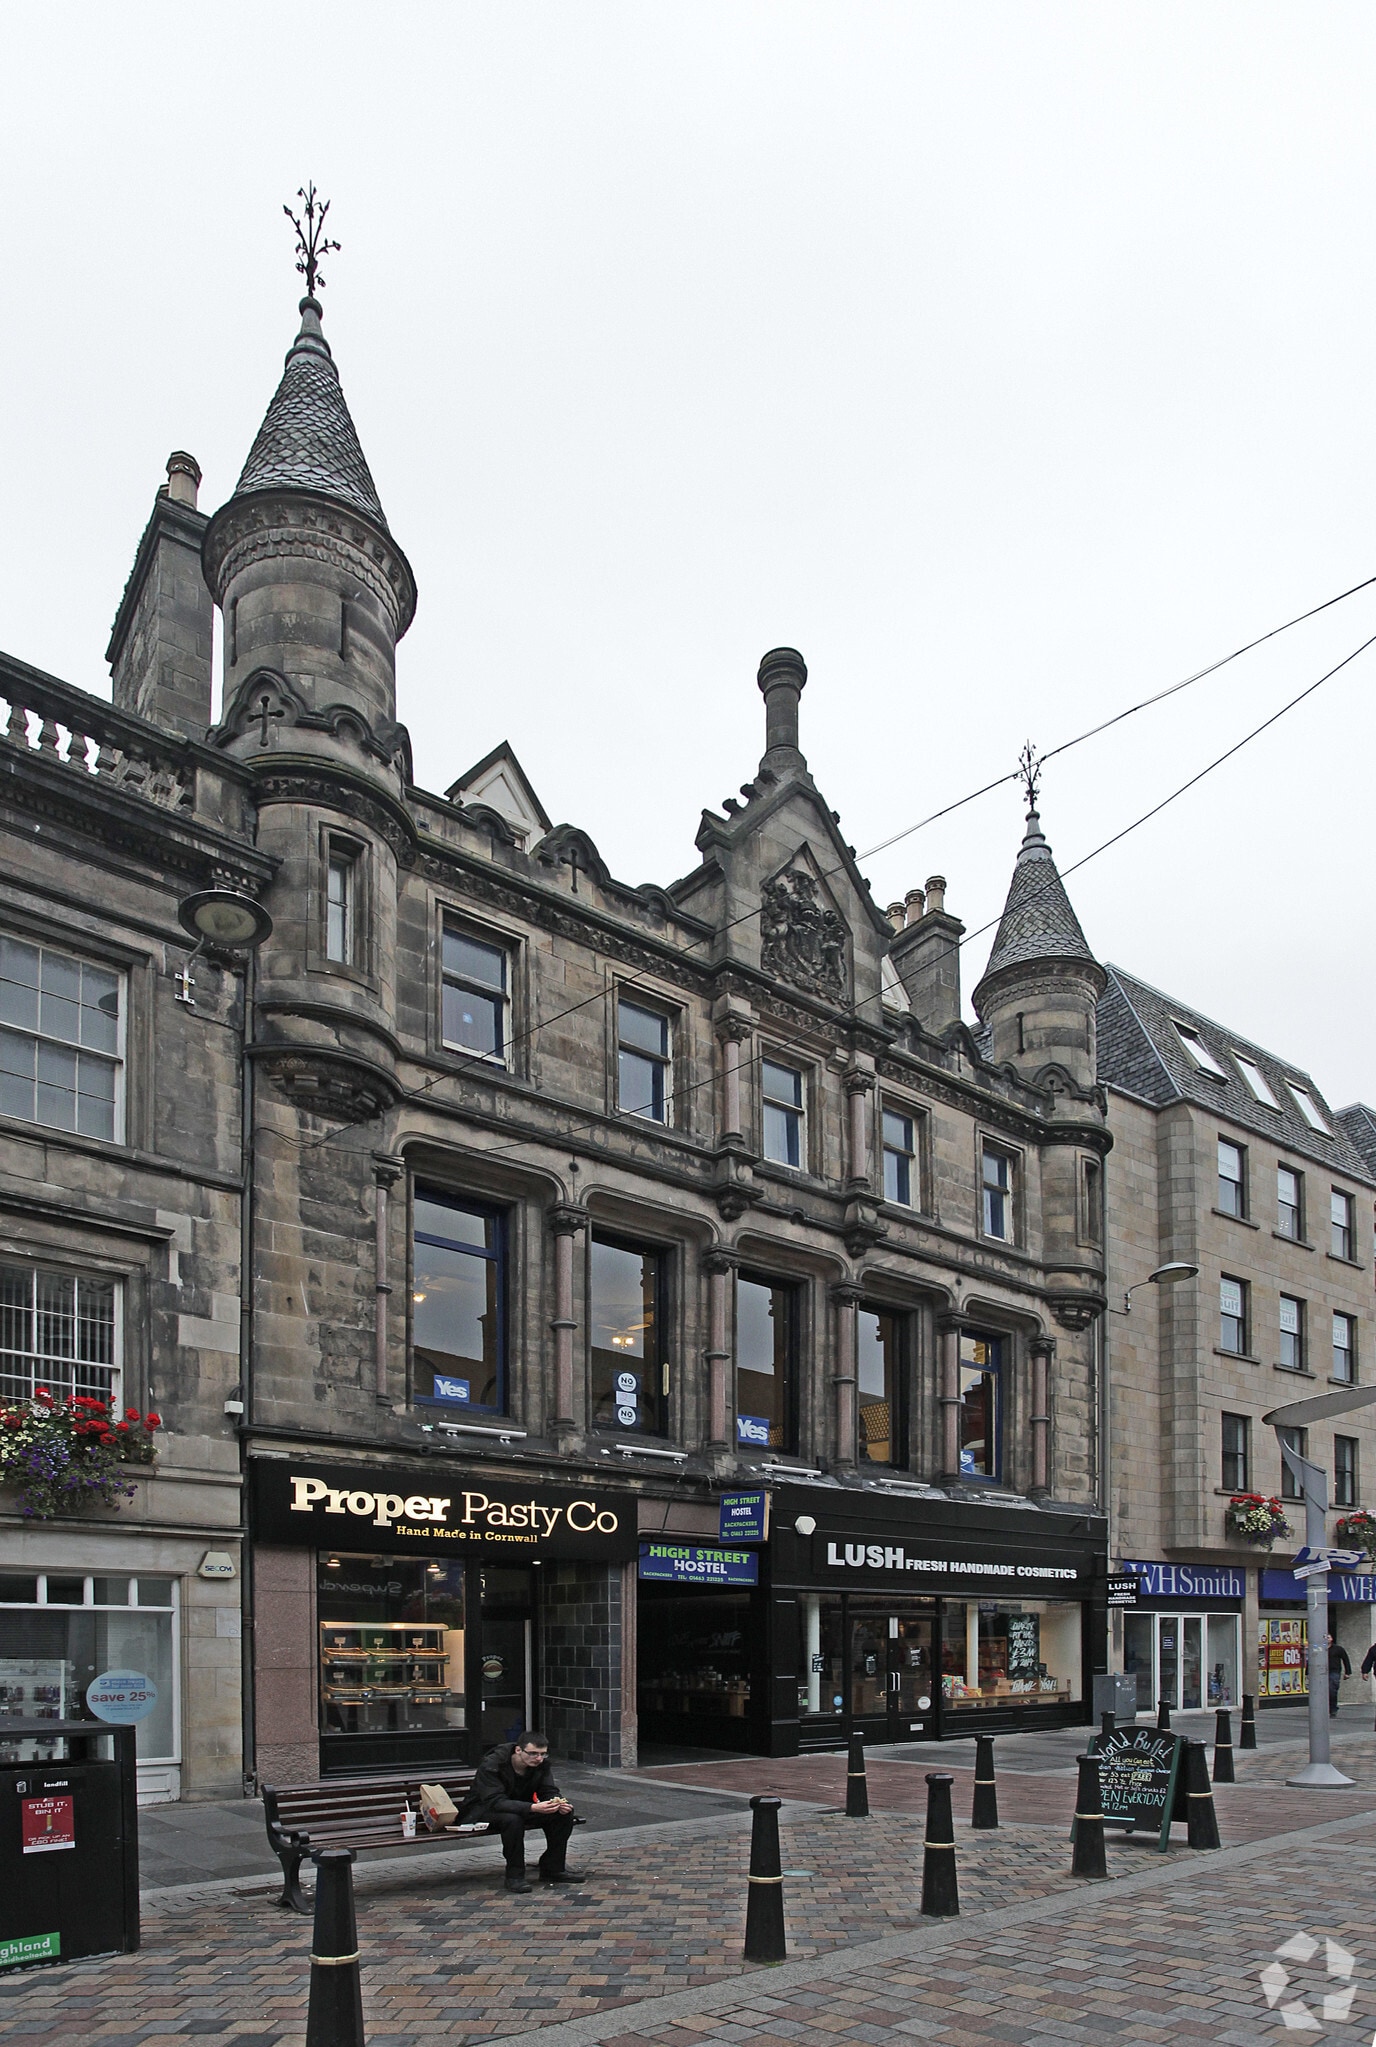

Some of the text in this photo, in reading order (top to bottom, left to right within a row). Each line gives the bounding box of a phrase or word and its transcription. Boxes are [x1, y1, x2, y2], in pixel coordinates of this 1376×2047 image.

[435, 1379, 468, 1398] Yes
[737, 1418, 768, 1440] Yes
[290, 1476, 618, 1537] Proper Pasty Co
[740, 1496, 761, 1504] STREET
[731, 1507, 752, 1516] HOSTEL
[396, 1526, 538, 1543] Hand Made in Cornwall
[649, 1545, 750, 1564] HIGH STREET
[827, 1542, 1078, 1579] LUSH FRESH HANDMADE COSMETICS
[674, 1560, 728, 1574] HOSTEL
[1108, 1582, 1136, 1590] LUSH
[1129, 1563, 1241, 1596] WHSmith
[1341, 1575, 1376, 1600] WH
[91, 1692, 156, 1702] save 25%
[1133, 1730, 1174, 1758] Buffet
[0, 1937, 51, 1958] ghland
